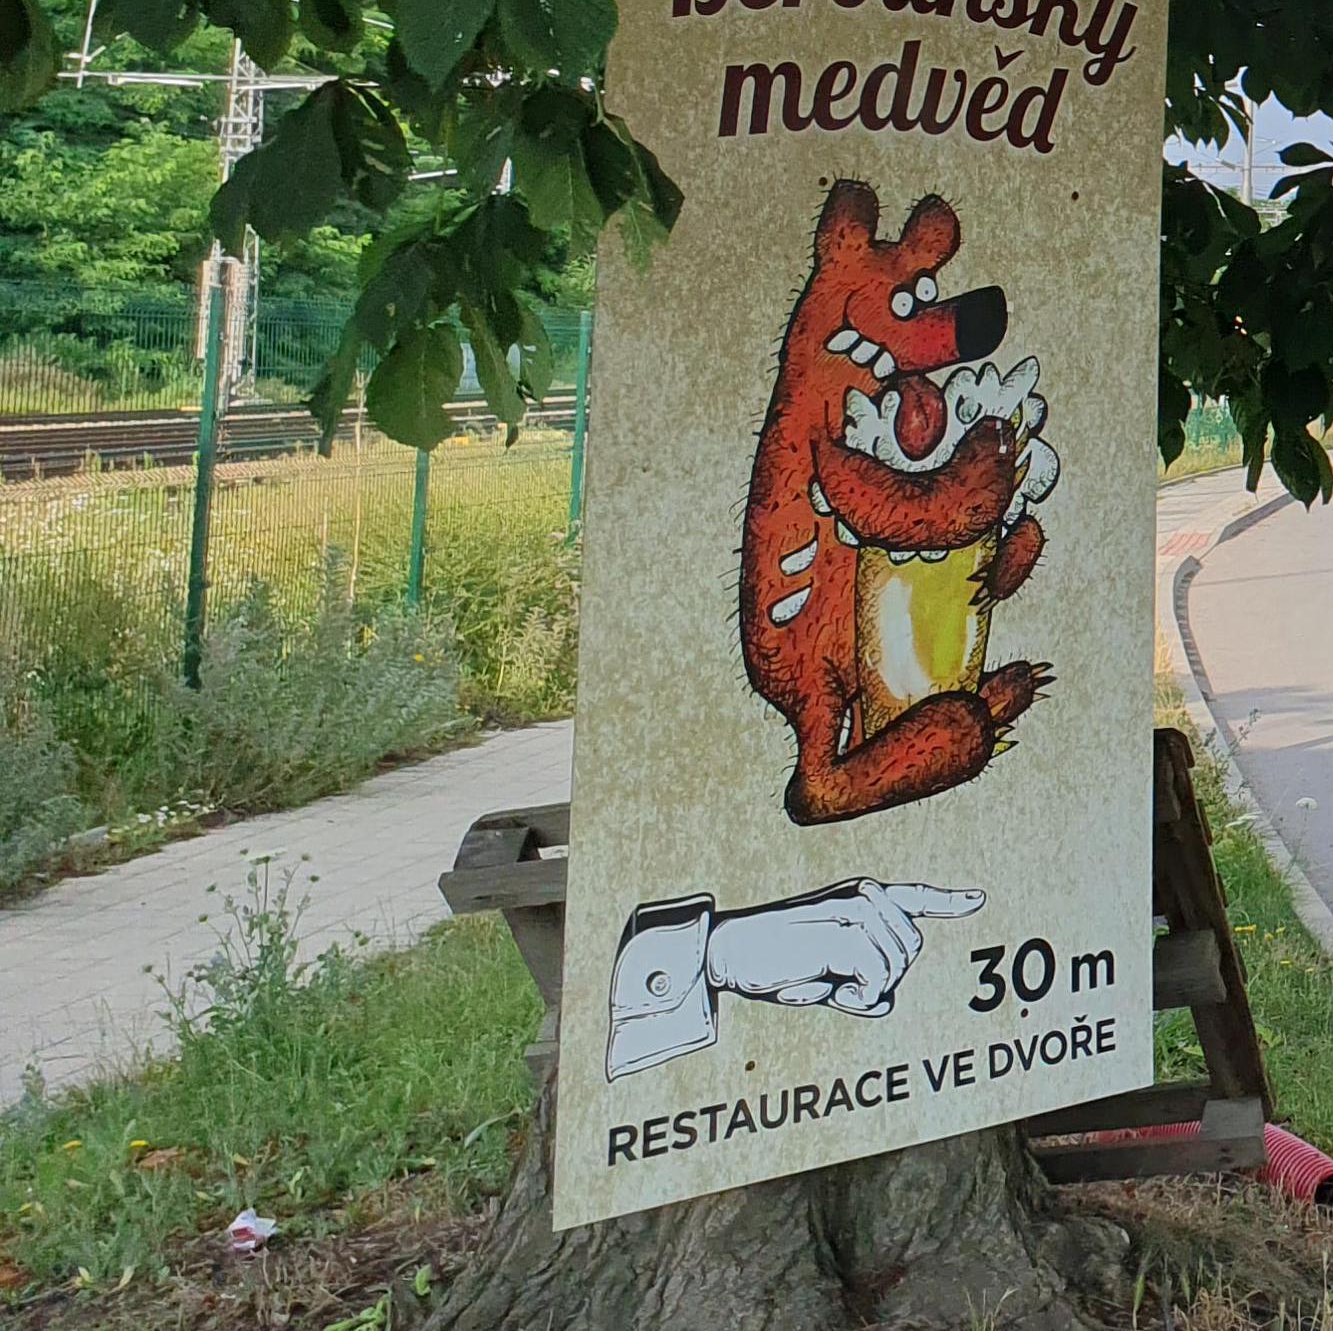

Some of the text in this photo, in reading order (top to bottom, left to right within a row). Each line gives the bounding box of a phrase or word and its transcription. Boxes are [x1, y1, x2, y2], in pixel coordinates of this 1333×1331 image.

[717, 39, 1071, 155] medvěd
[968, 937, 1116, 1013] 30 m
[607, 1015, 1117, 1166] RESTAURACE VE DVOŘE
